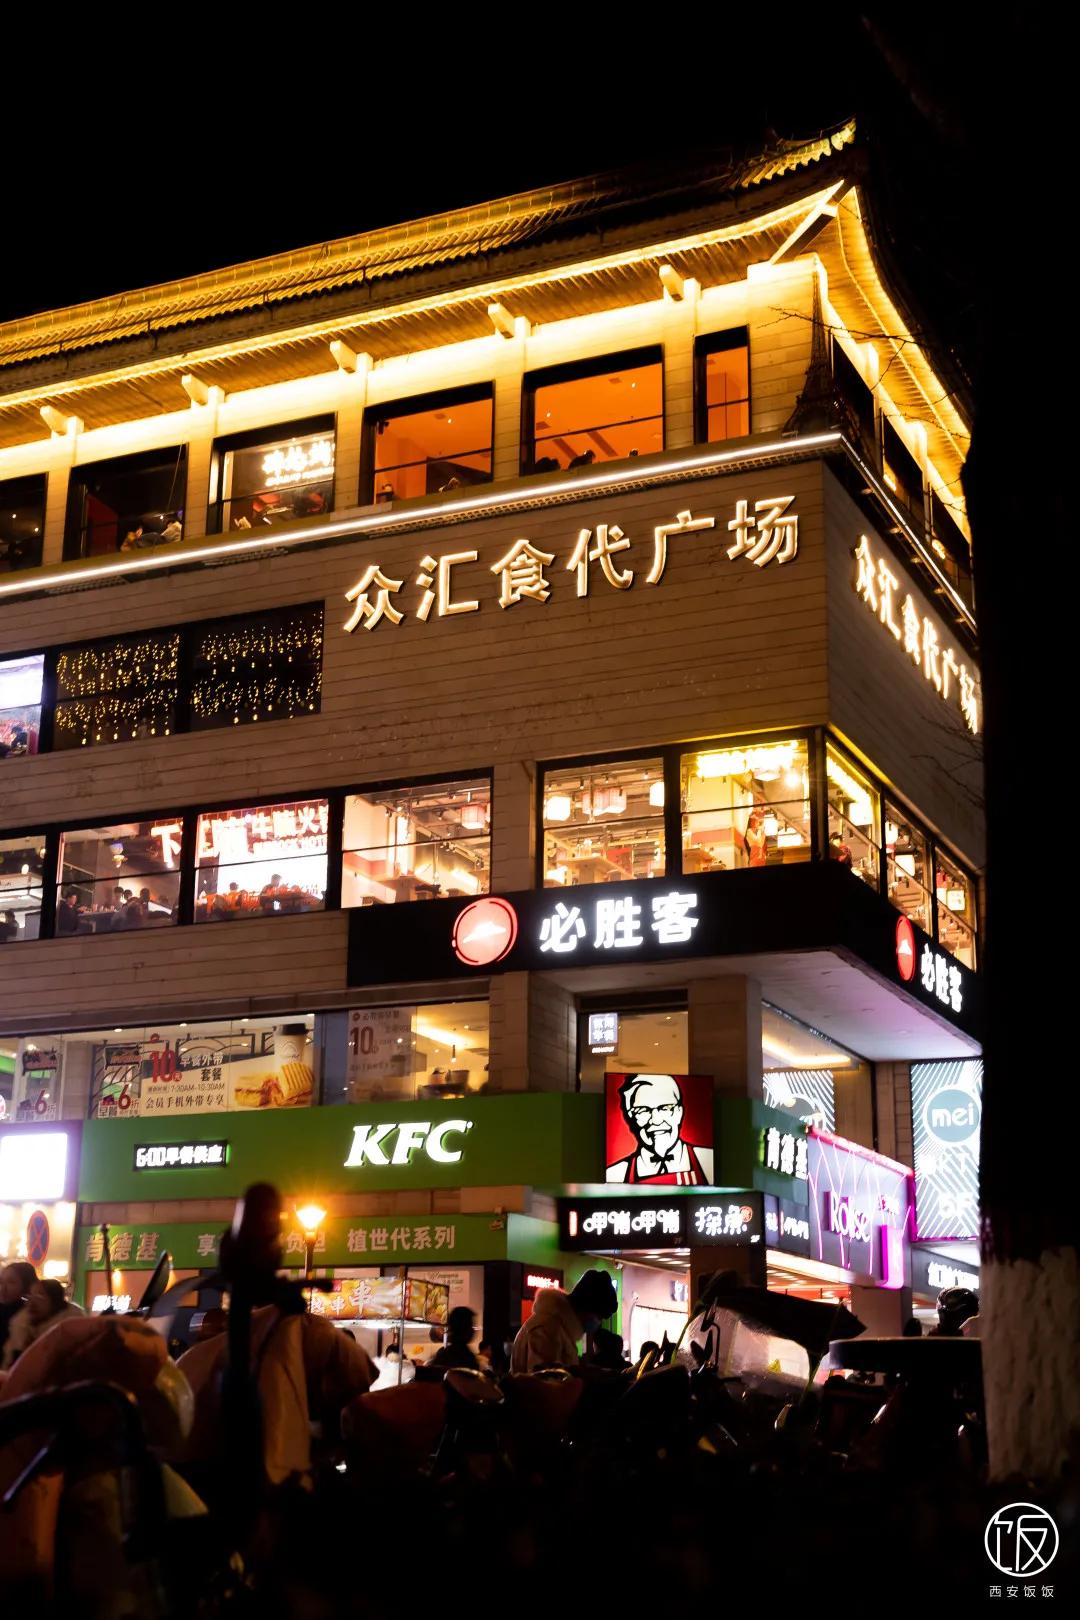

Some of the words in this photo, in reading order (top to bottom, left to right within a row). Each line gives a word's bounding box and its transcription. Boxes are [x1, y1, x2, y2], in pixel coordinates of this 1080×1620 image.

[343, 496, 799, 633] 众汇食代广场
[539, 892, 700, 953] 必胜客
[201, 1067, 222, 1082] 套餐
[145, 1094, 225, 1109] 会员手机外带专享
[931, 1102, 974, 1128] mei
[344, 1120, 473, 1167] KFC
[583, 1208, 680, 1236] 呷哺呷哺
[85, 1231, 159, 1262] 肯德基
[347, 1226, 456, 1252] 植世代系列
